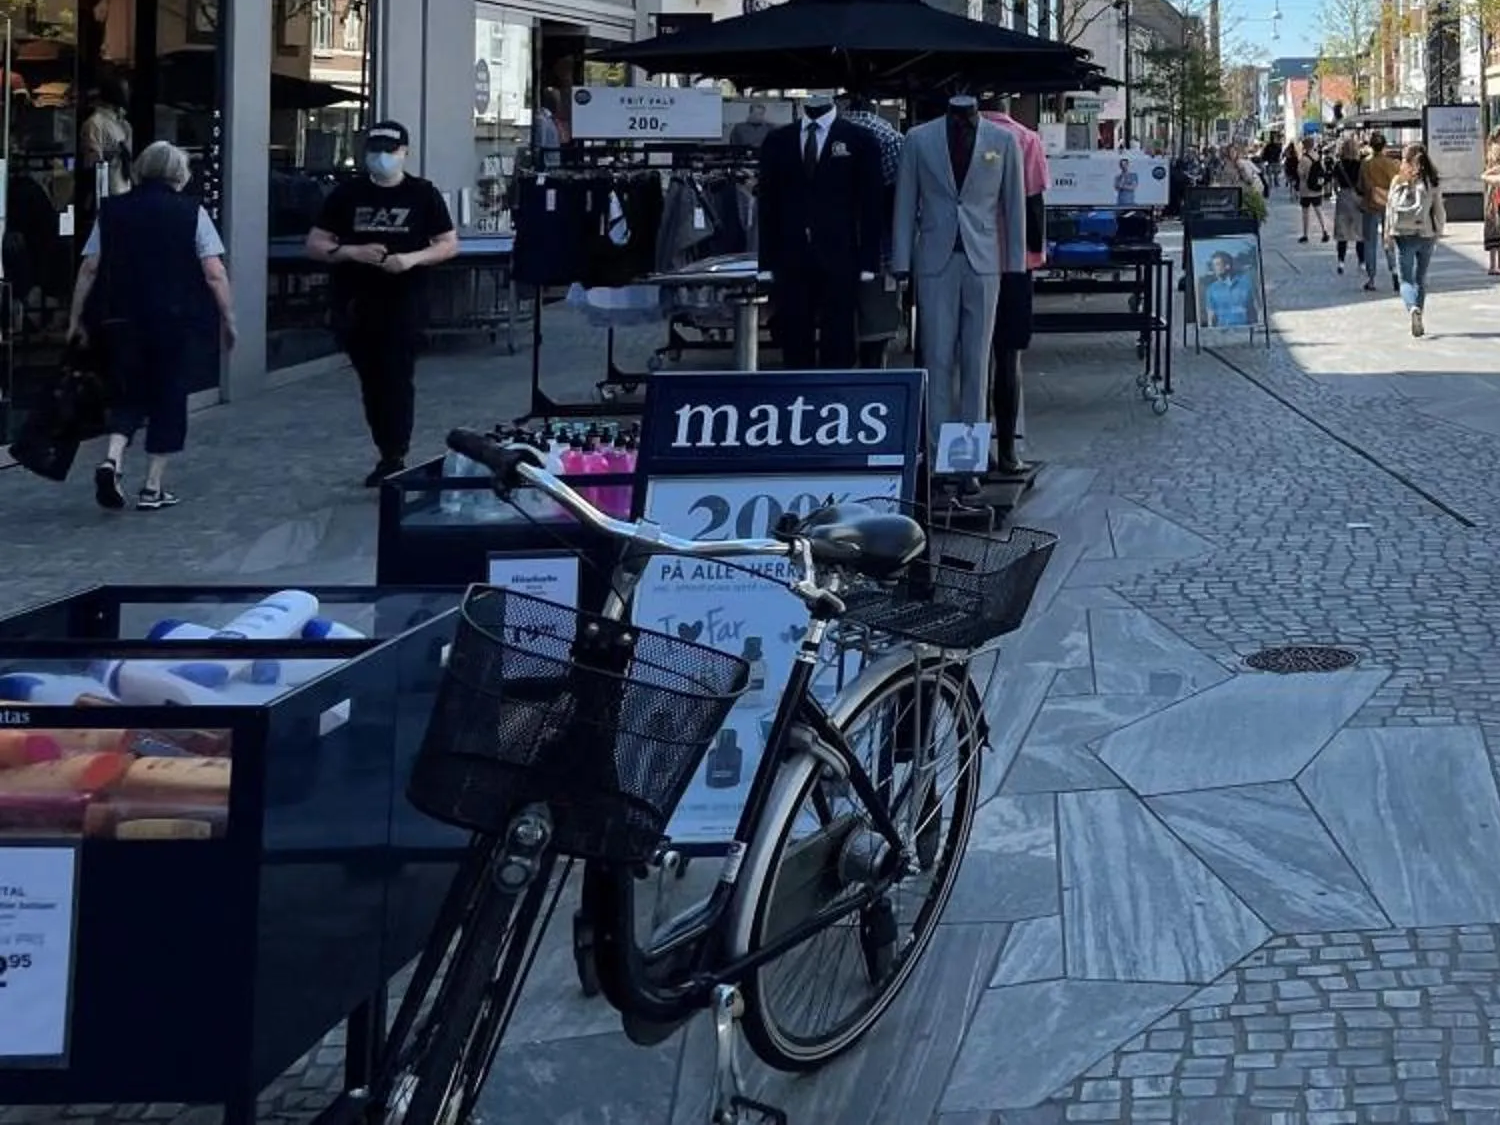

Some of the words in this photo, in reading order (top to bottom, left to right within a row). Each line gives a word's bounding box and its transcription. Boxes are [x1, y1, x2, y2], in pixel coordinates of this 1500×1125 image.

[354, 207, 411, 226] EA7
[671, 395, 889, 448] matas
[661, 559, 685, 582] PÅ
[691, 563, 736, 581] ALLE
[706, 606, 747, 645] Far
[0, 709, 31, 724] tas
